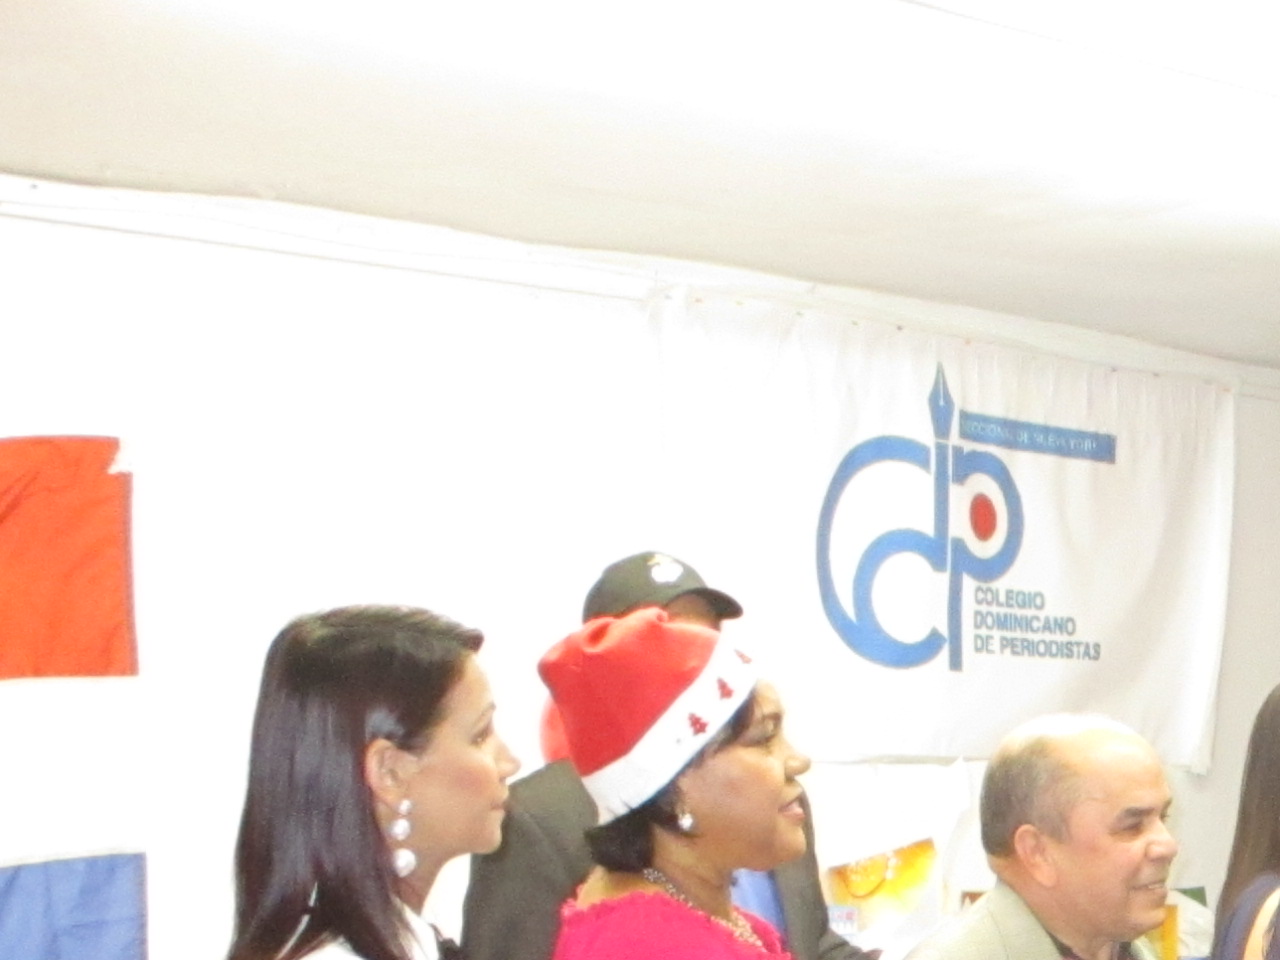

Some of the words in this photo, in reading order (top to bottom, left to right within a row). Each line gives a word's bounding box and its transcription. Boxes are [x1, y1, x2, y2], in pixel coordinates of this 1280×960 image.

[974, 586, 1045, 610] COLEGIO
[974, 610, 1076, 636] DOMINICANO
[974, 633, 996, 654] DE
[999, 636, 1101, 661] PERIODISTAS
